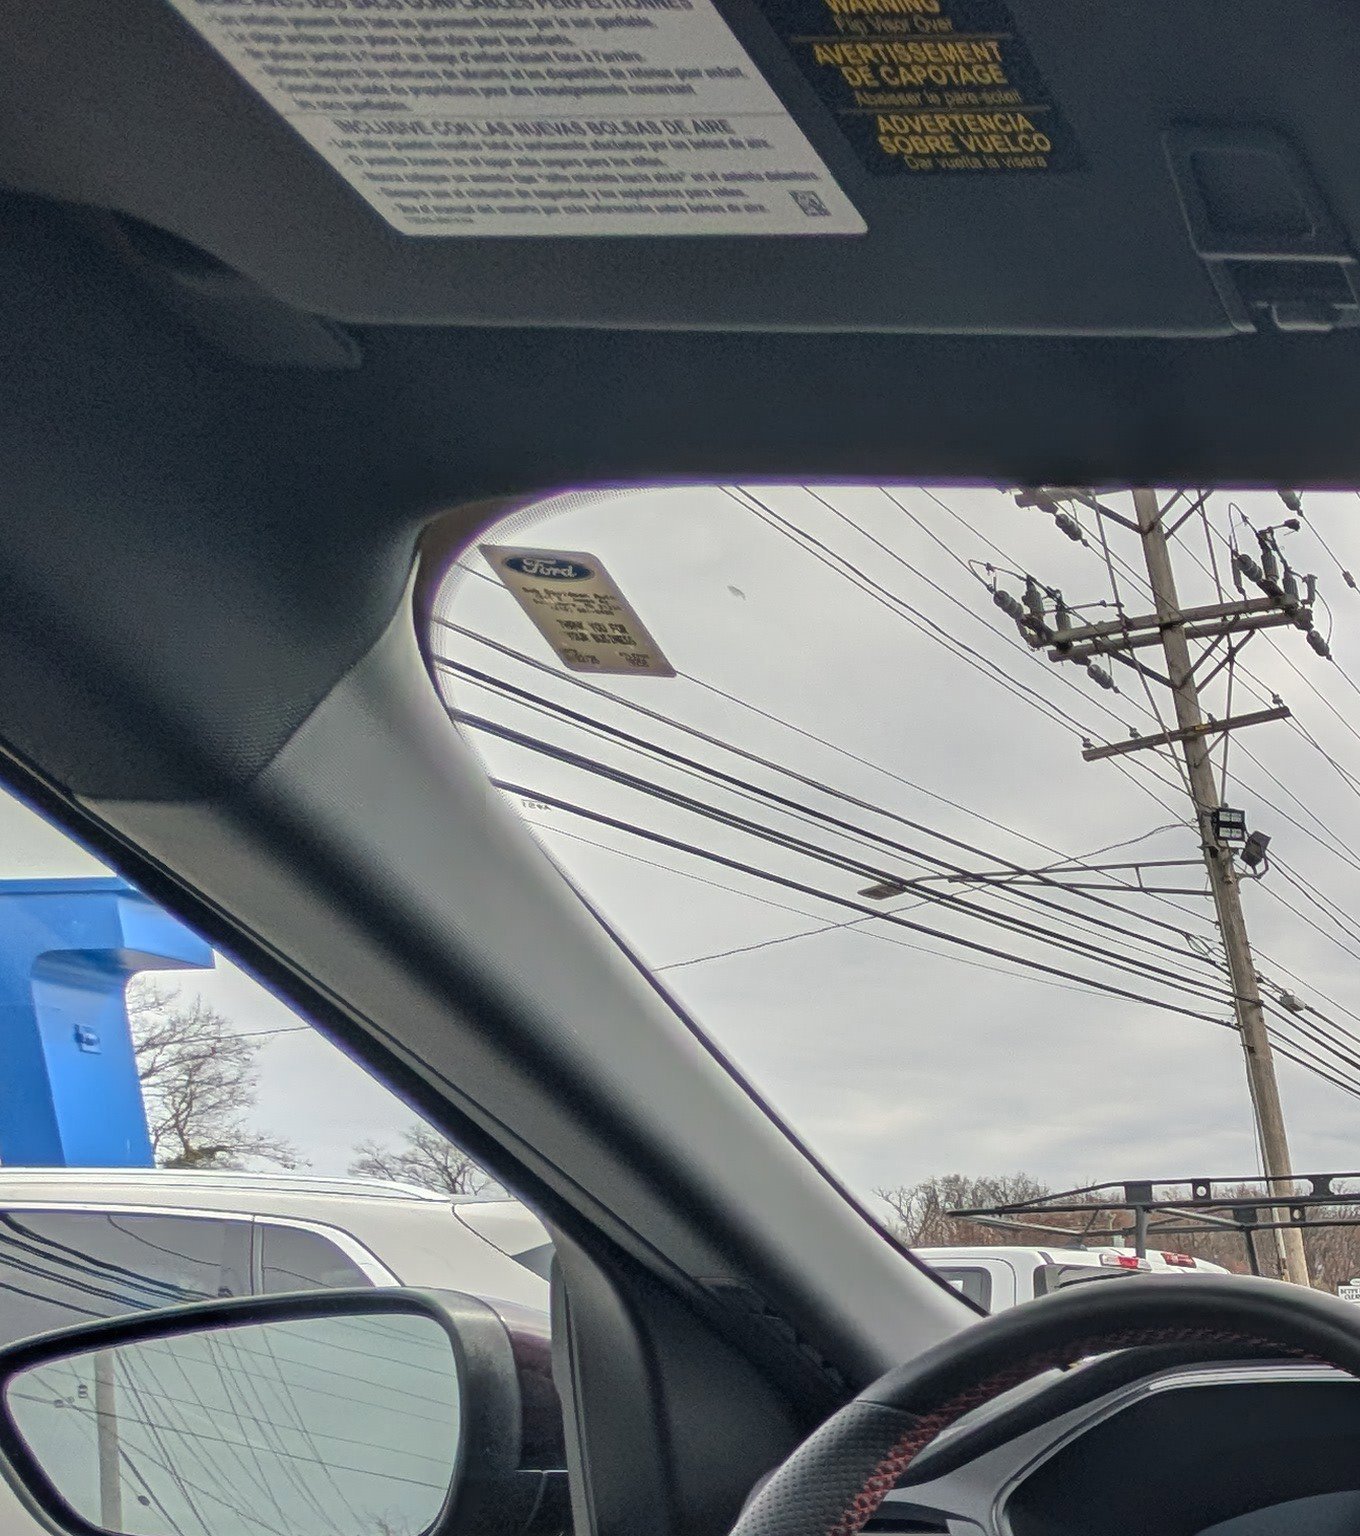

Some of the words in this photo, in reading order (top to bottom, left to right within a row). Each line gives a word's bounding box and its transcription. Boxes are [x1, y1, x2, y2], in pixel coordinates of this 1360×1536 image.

[814, 41, 1003, 64] AVERTISSEMENT
[841, 66, 880, 87] DE
[879, 64, 1009, 86] CAPOTAGE
[877, 113, 1037, 134] ADVERTENCIA
[878, 133, 959, 155] SOBRE
[957, 133, 1053, 154] VUELCO
